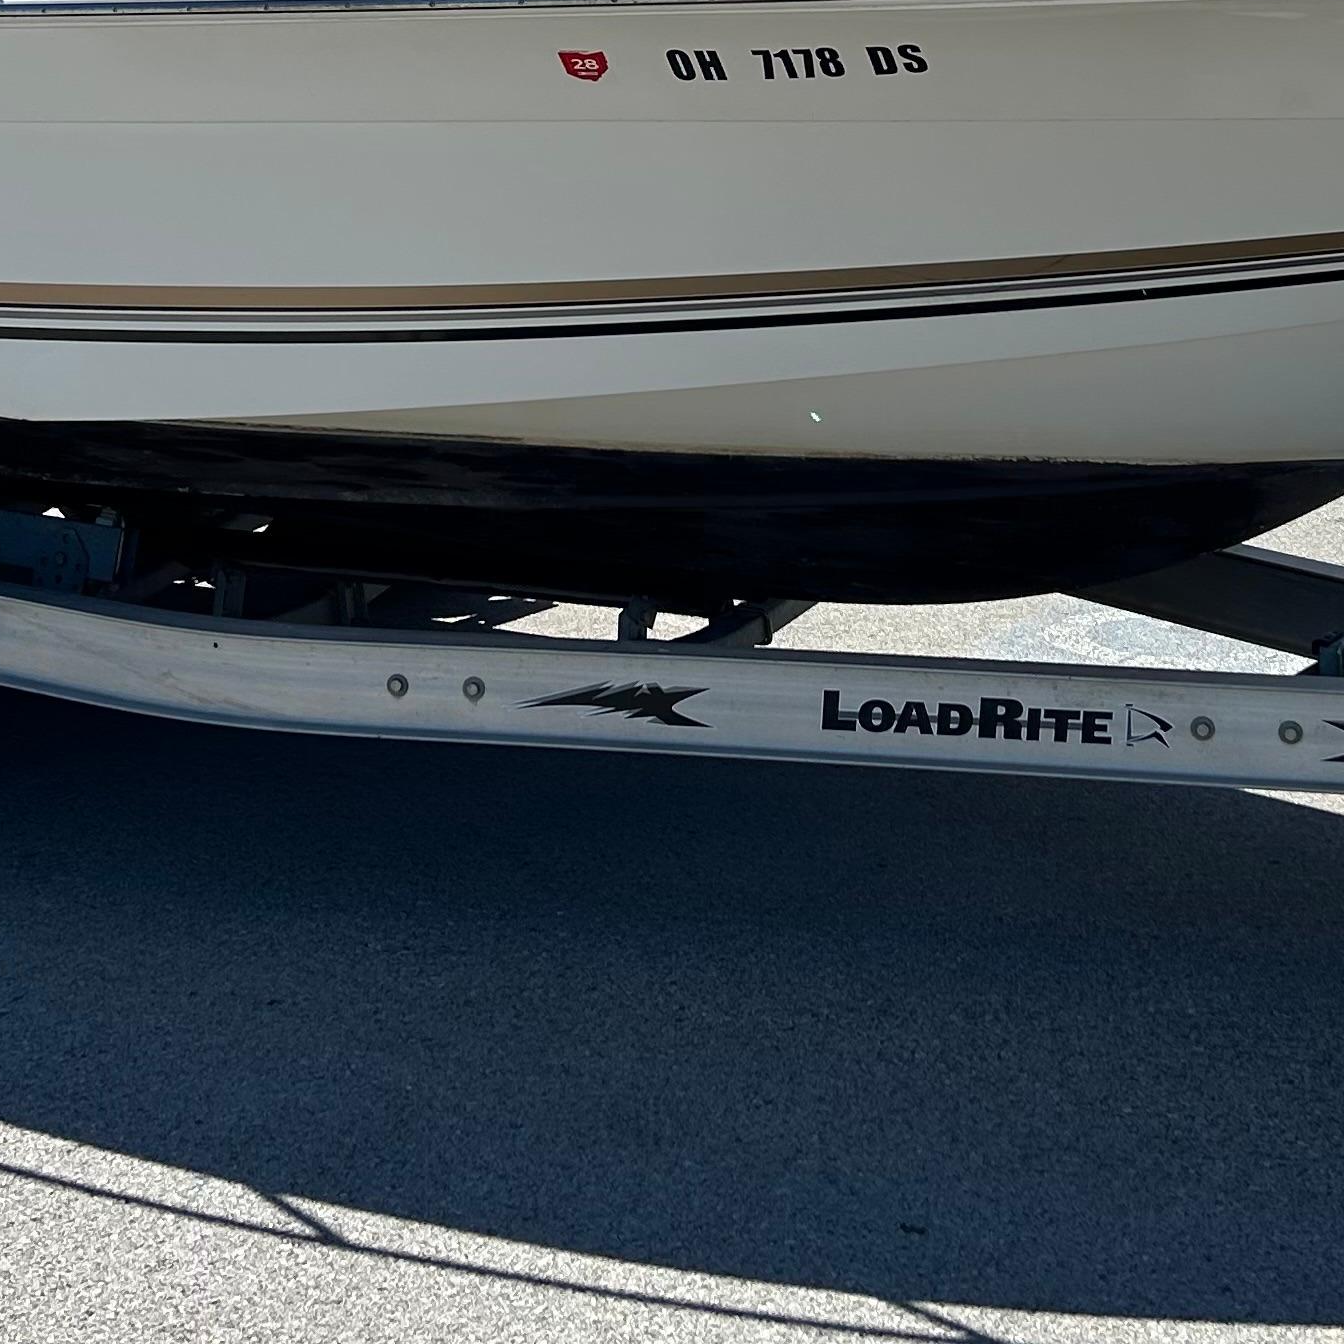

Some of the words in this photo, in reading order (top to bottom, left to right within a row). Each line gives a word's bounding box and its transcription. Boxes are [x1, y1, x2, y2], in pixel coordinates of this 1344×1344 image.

[571, 58, 599, 70] 28
[665, 48, 728, 81] OH
[750, 47, 846, 80] 7178
[864, 43, 929, 76] DS
